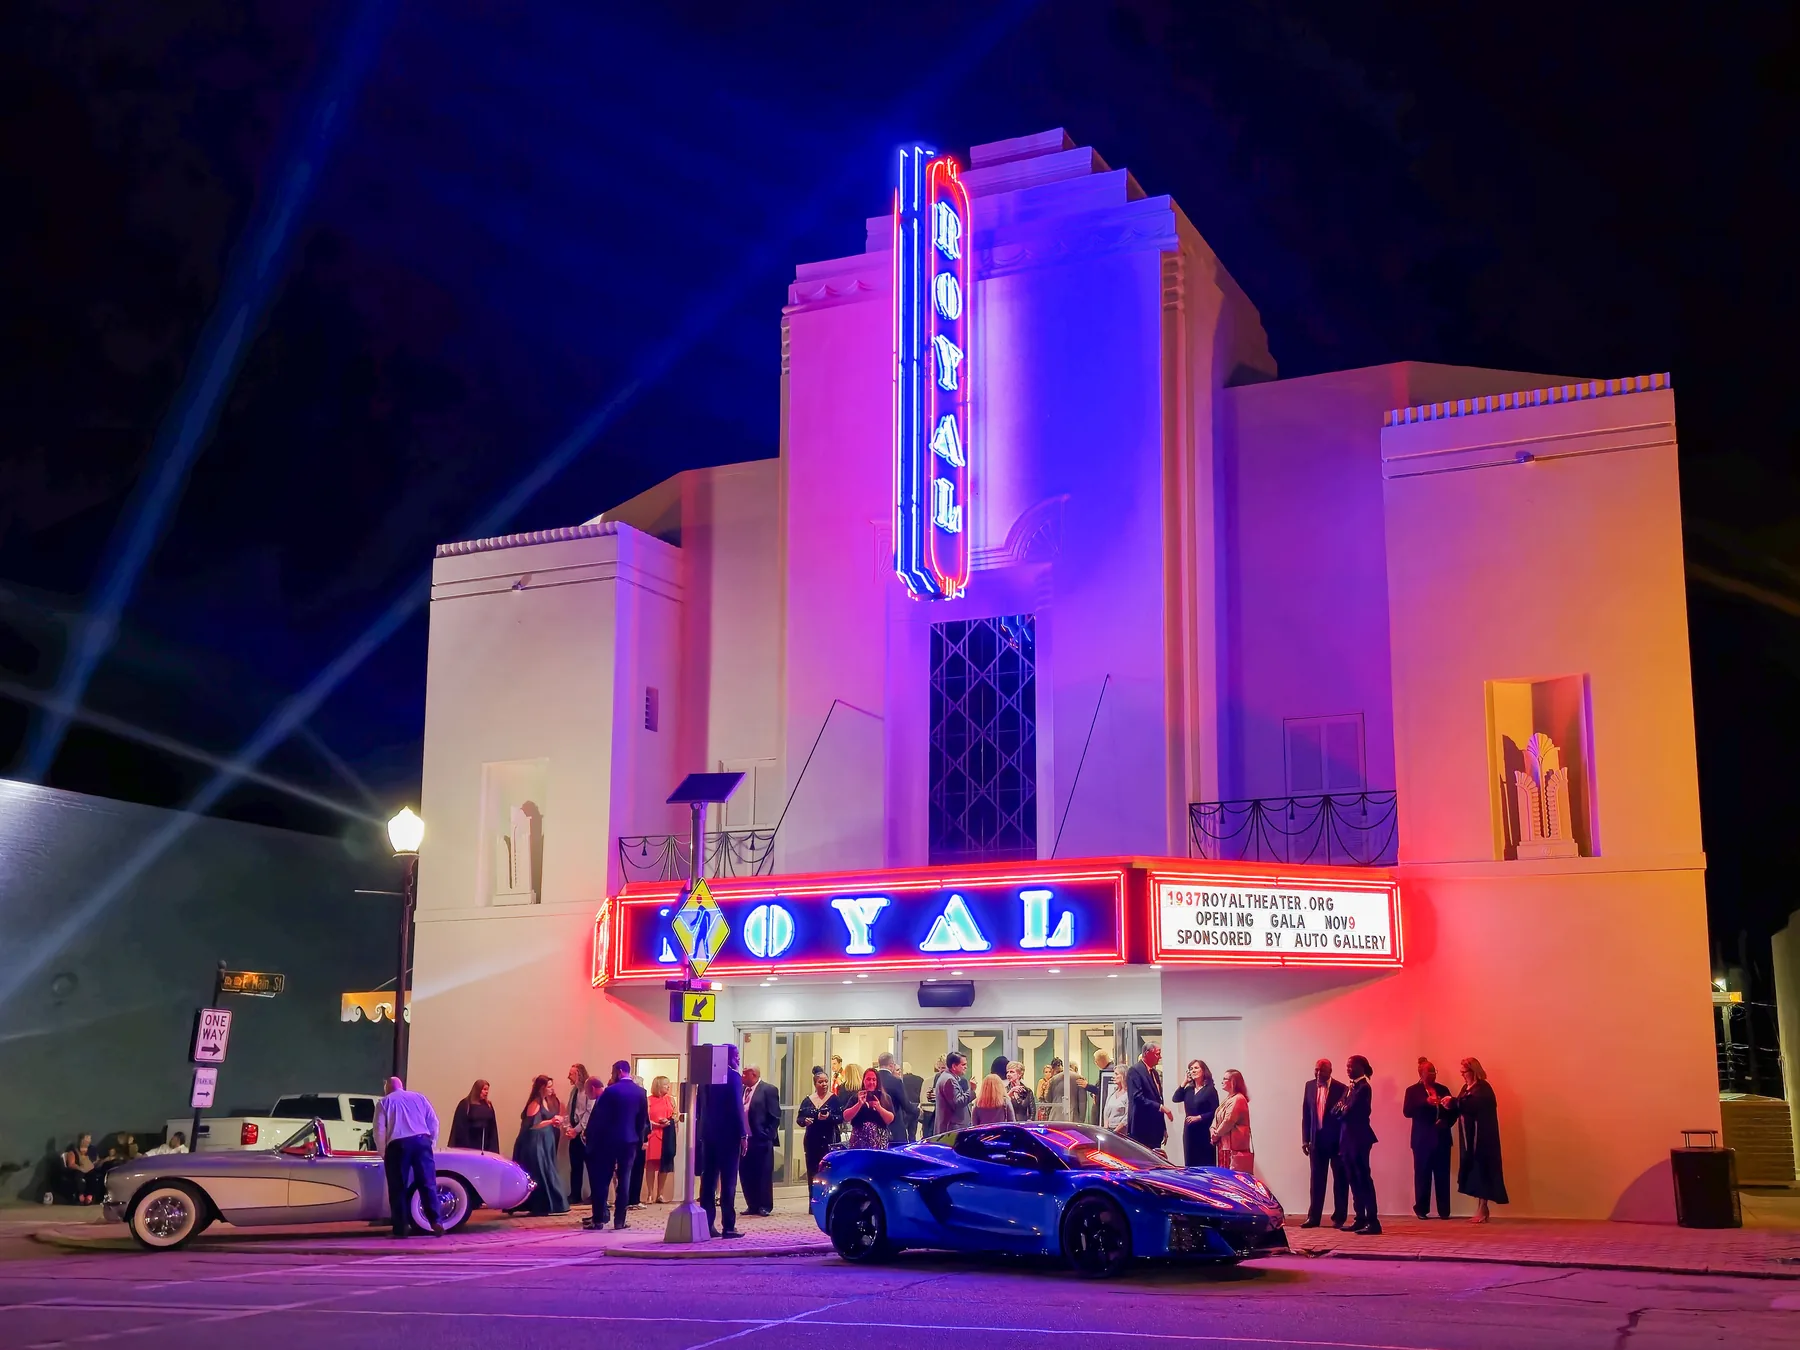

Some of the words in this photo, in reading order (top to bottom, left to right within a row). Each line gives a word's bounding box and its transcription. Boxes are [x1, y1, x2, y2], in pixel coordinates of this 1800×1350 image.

[930, 201, 965, 533] ROYAL
[1196, 911, 1254, 928] OPENING
[1270, 913, 1306, 929] GALA
[1177, 929, 1252, 946] SPONSORED
[1265, 932, 1281, 947] BY
[1294, 932, 1328, 948] AUTO
[1334, 934, 1386, 950] GALLERY
[252, 975, 269, 990] Main
[205, 1015, 227, 1027] ONE
[202, 1028, 225, 1041] WAY
